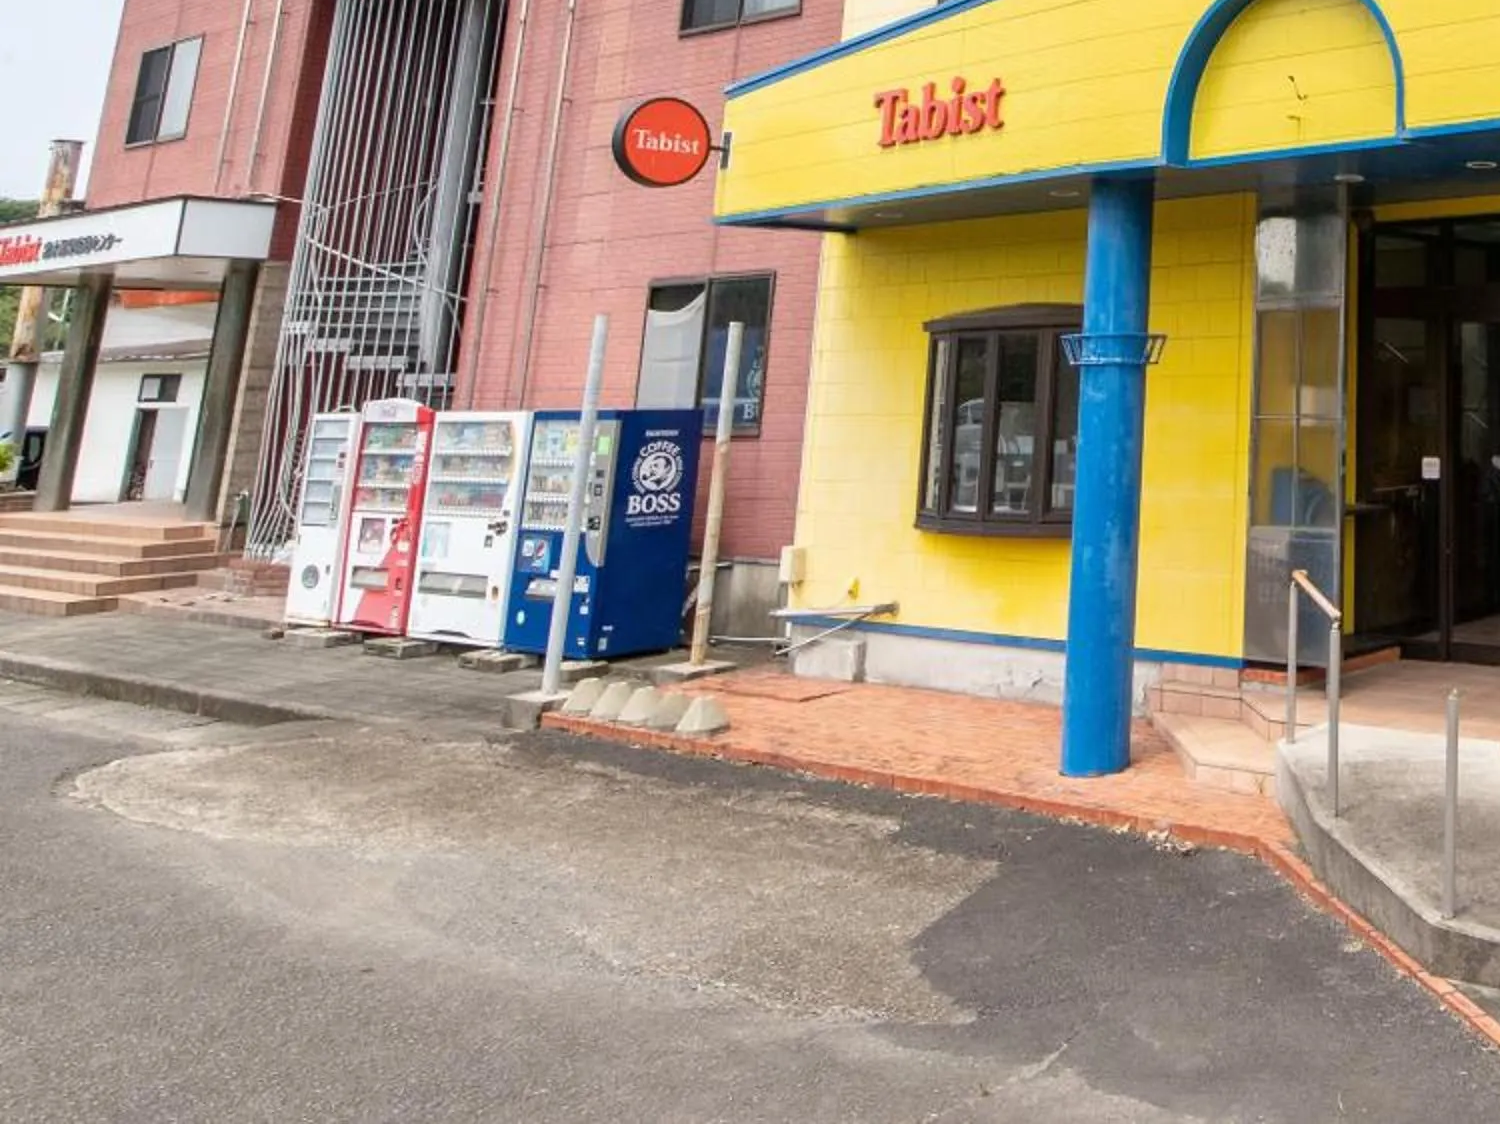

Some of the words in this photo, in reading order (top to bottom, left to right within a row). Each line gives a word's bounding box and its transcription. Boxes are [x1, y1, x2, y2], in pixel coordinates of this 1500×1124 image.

[876, 76, 1005, 148] Tabist
[633, 128, 700, 156] Tabist
[640, 440, 681, 457] COFFEE
[626, 493, 681, 515] BOSS
